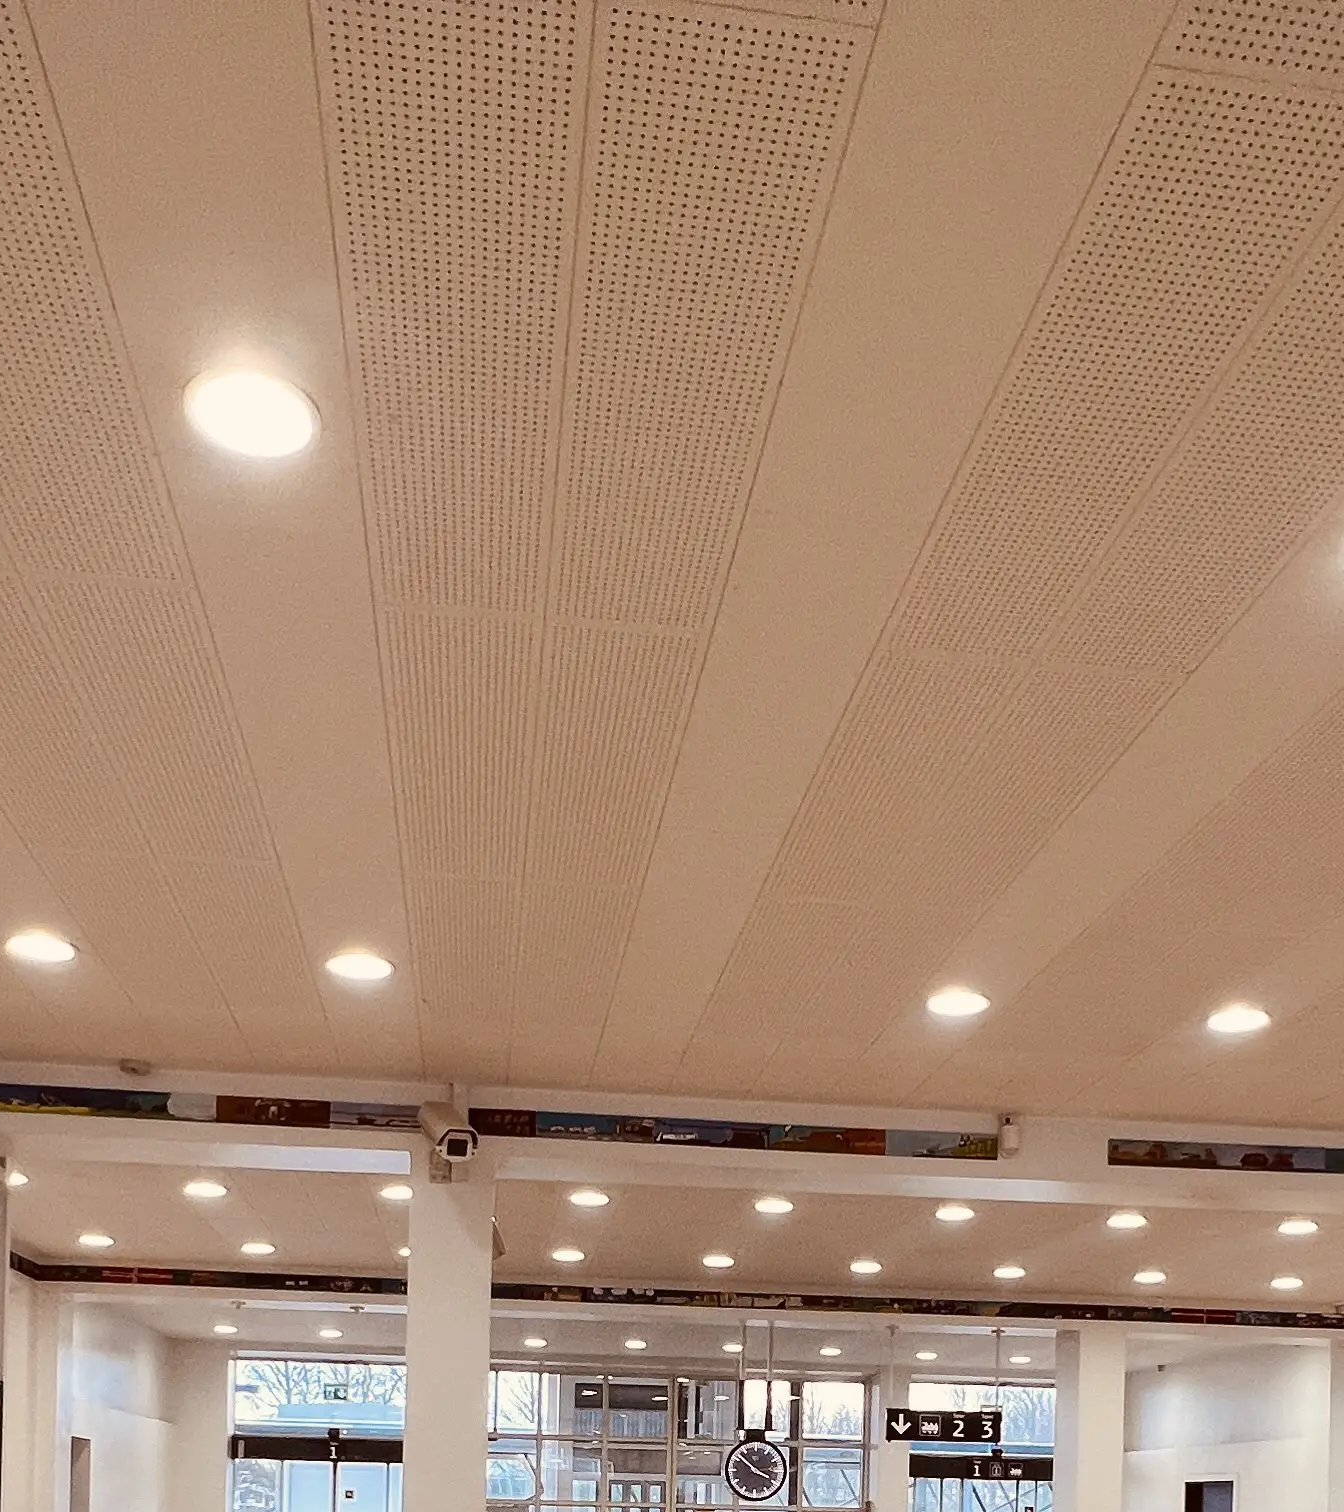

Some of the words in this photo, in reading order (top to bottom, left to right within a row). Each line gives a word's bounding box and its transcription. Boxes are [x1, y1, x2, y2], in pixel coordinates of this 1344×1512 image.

[952, 1419, 965, 1438] 2
[981, 1420, 993, 1439] 3
[329, 1446, 338, 1459] 1
[972, 1464, 981, 1477] 1
